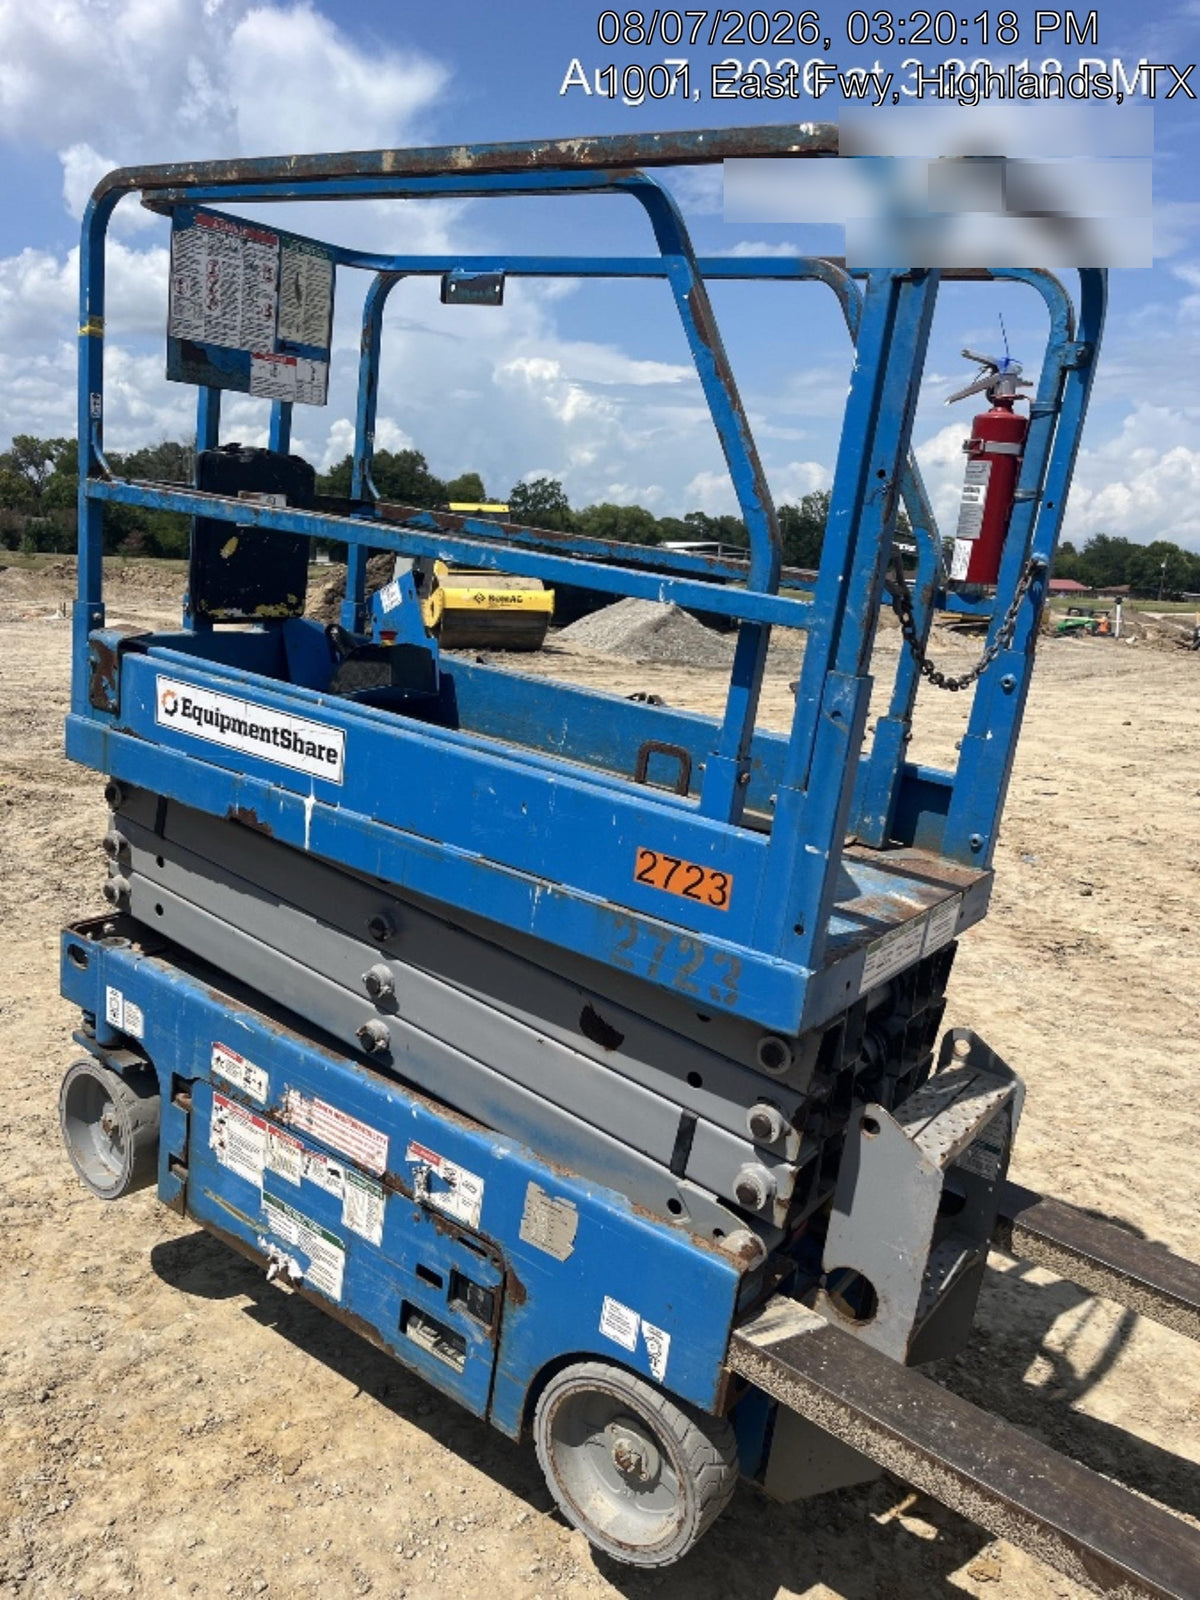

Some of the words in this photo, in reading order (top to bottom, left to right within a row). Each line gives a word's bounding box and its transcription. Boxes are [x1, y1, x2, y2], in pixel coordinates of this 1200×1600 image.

[180, 696, 339, 765] EquipmentShare
[636, 850, 729, 907] 2723
[609, 915, 742, 1007] 2723
